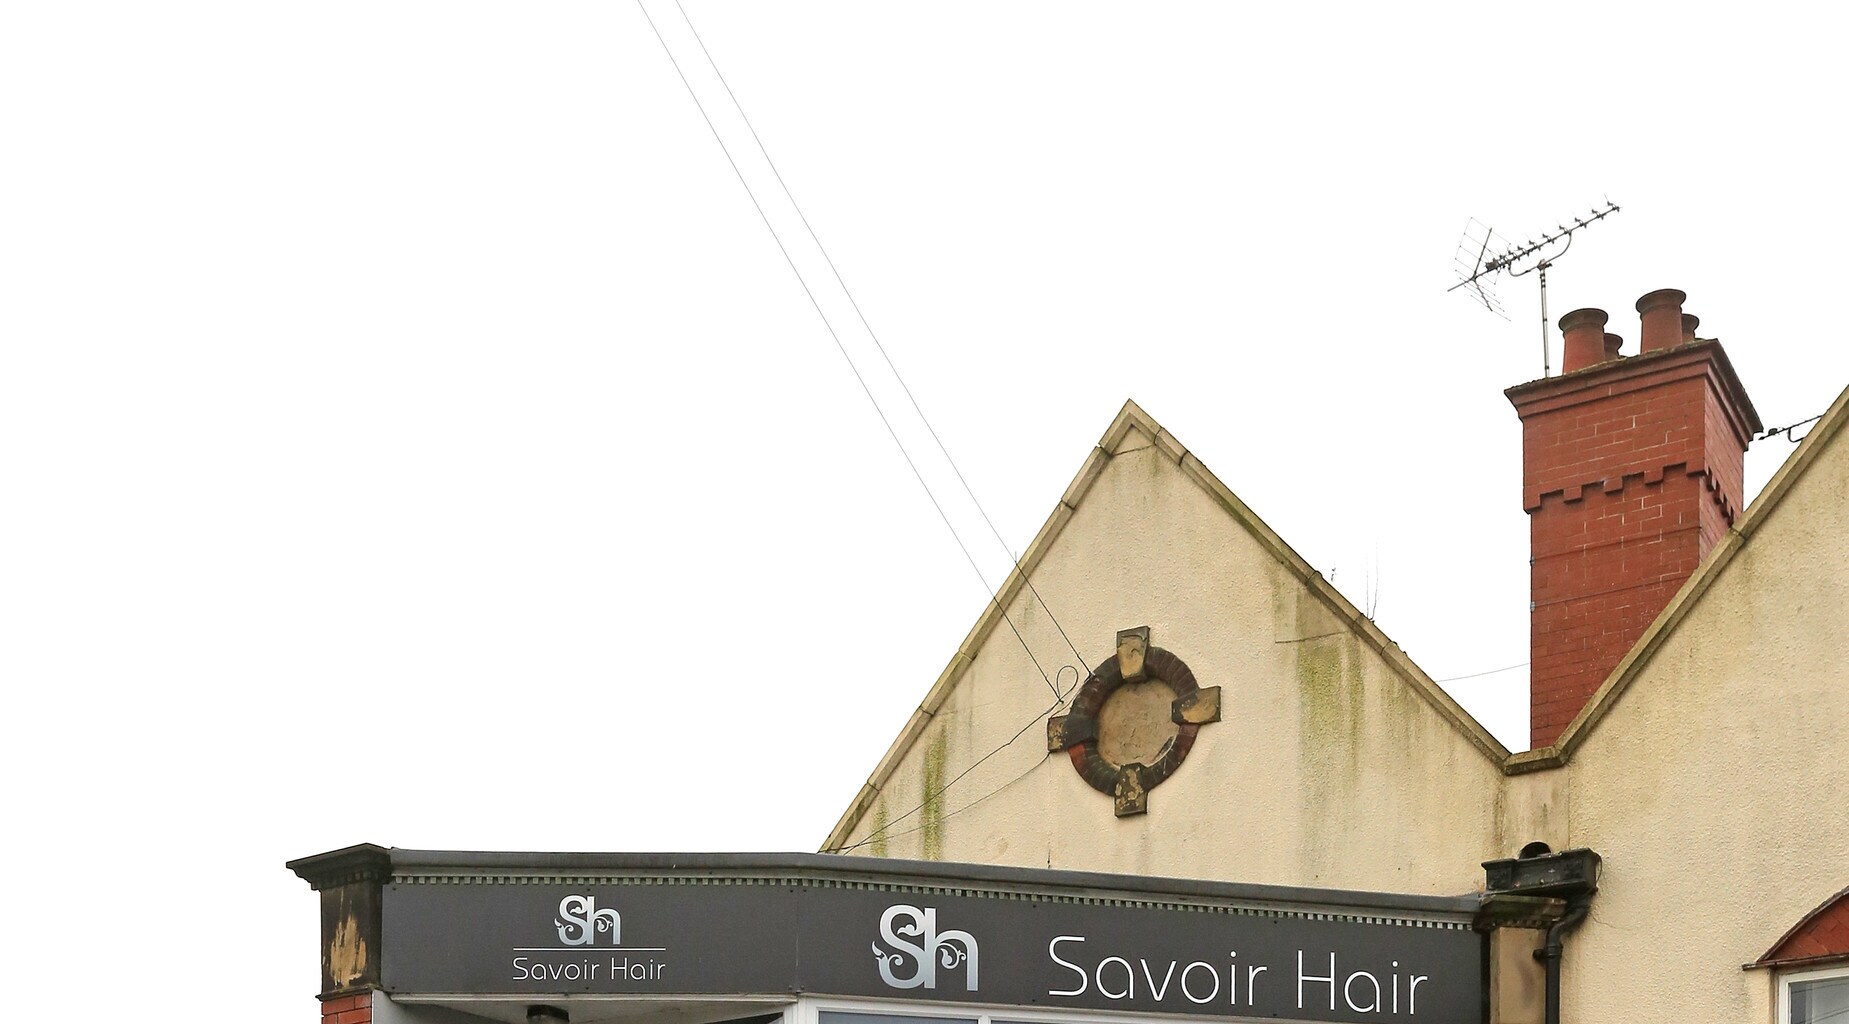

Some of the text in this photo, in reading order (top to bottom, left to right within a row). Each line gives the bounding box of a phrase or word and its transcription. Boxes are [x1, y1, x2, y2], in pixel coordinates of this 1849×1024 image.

[512, 957, 666, 981] Savoir Hair
[1048, 934, 1428, 1015] Savoir Hair
